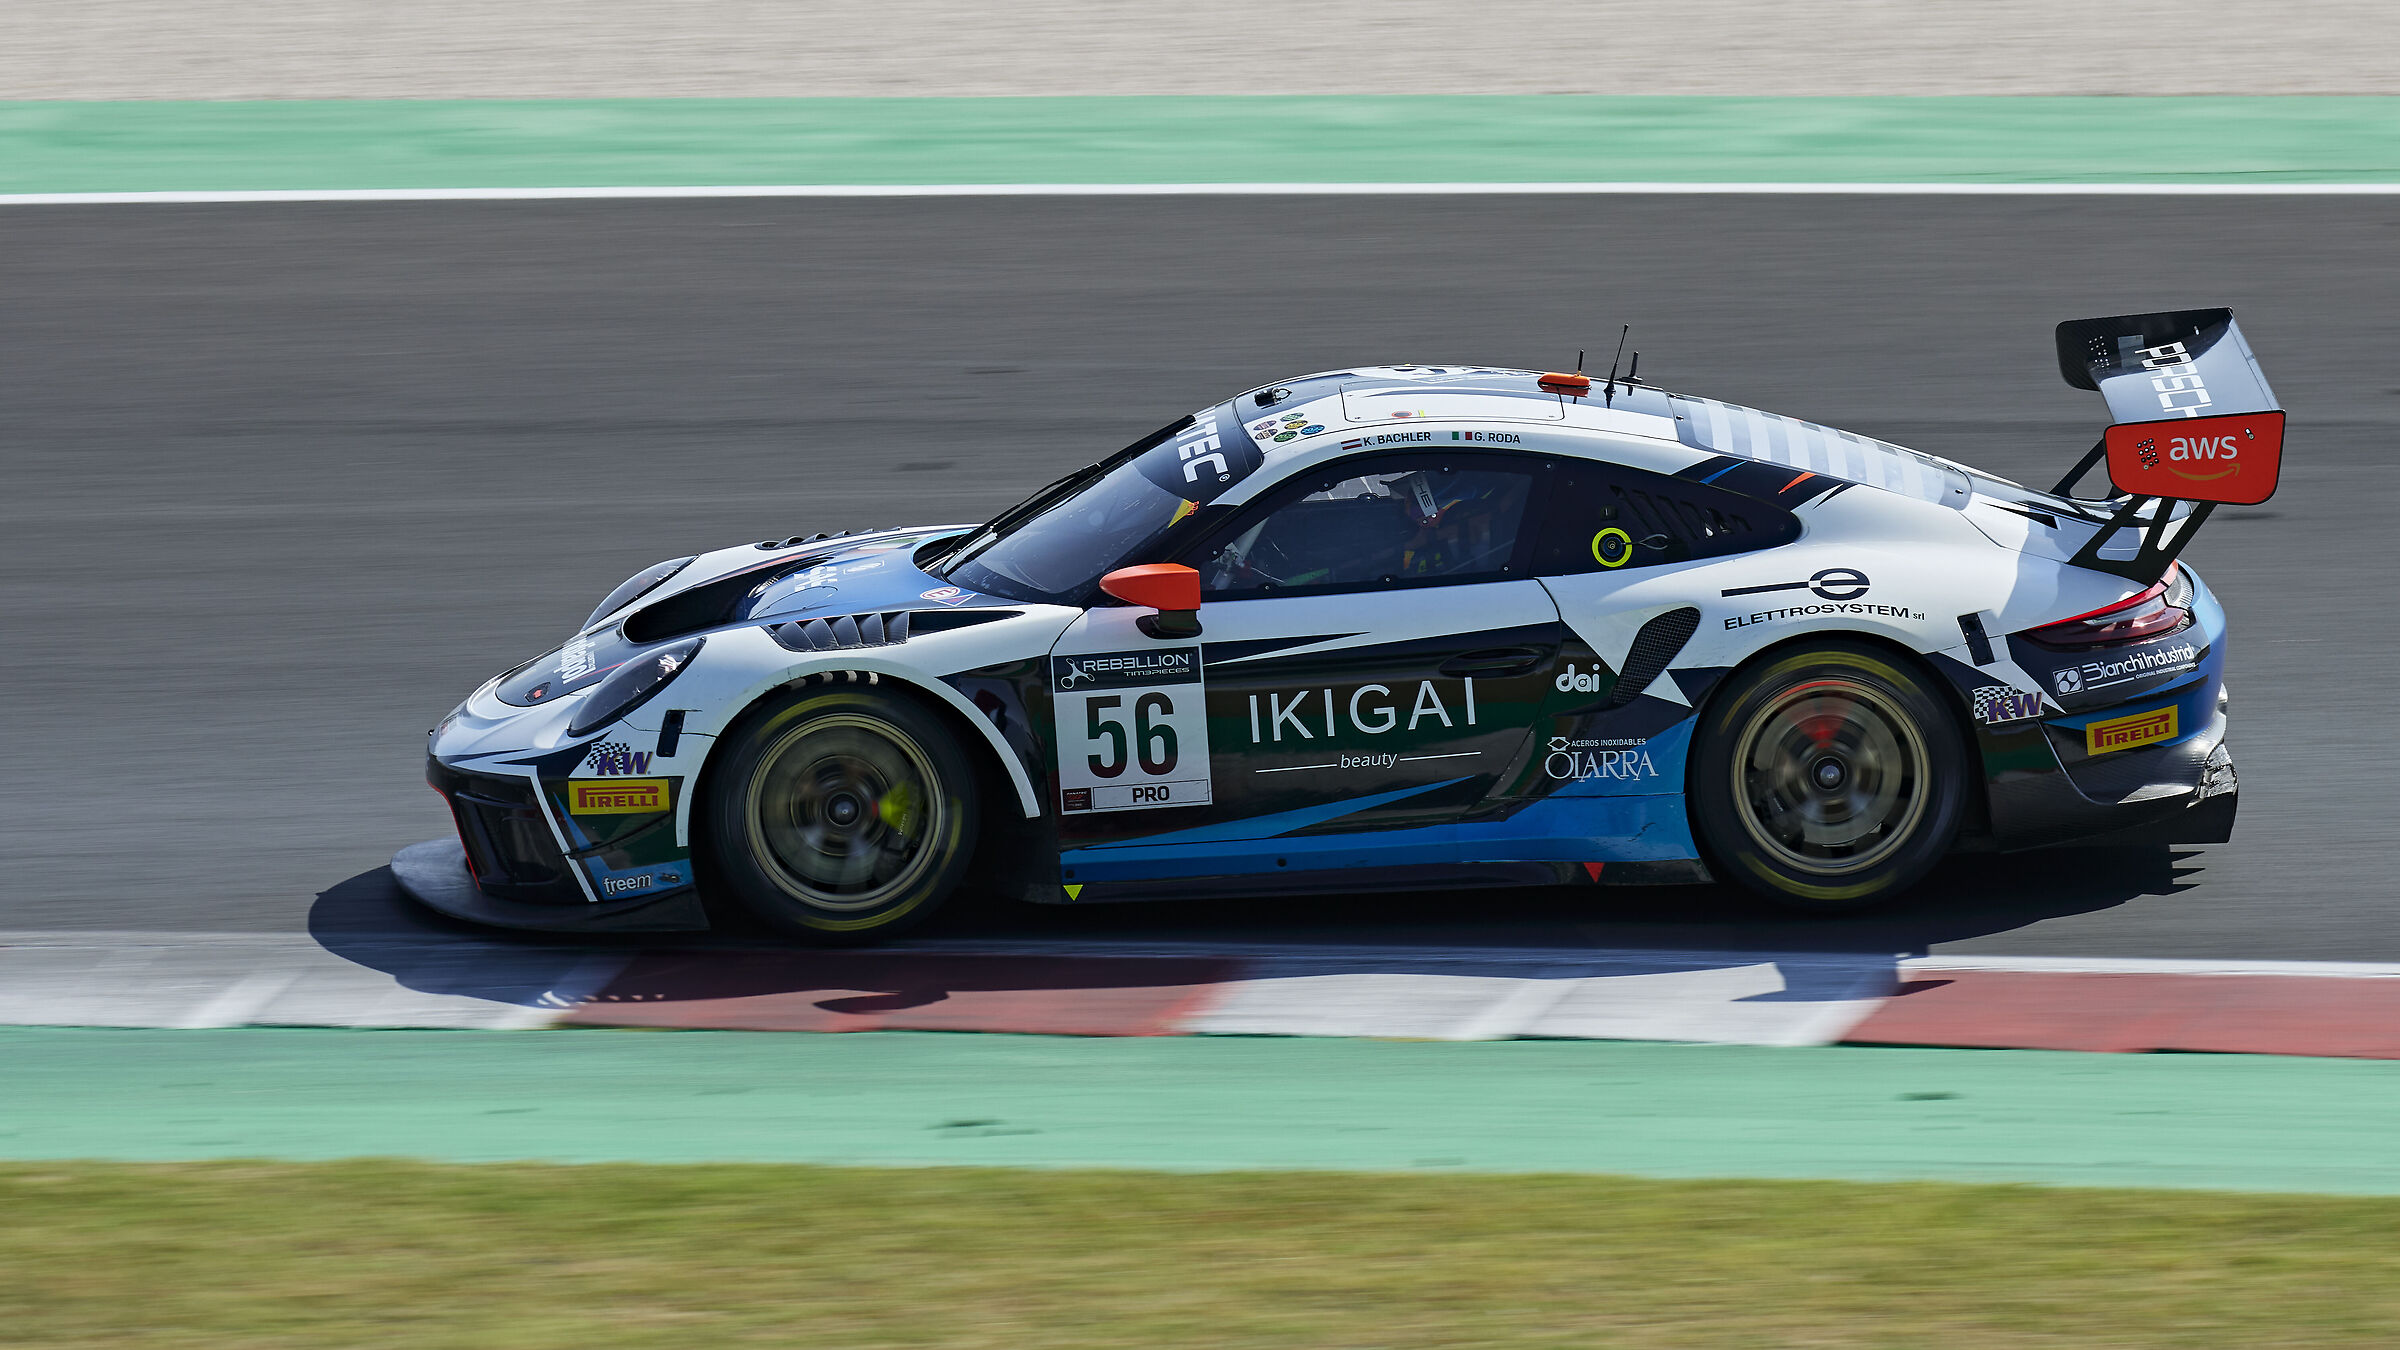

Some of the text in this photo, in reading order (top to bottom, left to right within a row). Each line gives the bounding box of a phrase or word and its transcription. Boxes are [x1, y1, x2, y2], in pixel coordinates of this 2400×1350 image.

[1363, 431, 1432, 446] K. BACHLER
[1474, 432, 1521, 444] G. RODA
[2169, 436, 2238, 461] aws
[1724, 603, 1925, 631] ELETTROSYSTEM srl
[1082, 653, 1190, 673] REBELLION
[1555, 663, 1600, 693] dai
[1249, 676, 1477, 744] IKIGAI
[1988, 691, 2042, 722] KW
[1086, 691, 1179, 779] 56
[1571, 738, 1647, 748] ACEROS INOXIDABLES
[2094, 713, 2170, 749] PIRELLI
[596, 751, 654, 776] KW
[1340, 752, 1398, 769] beauty
[1544, 750, 1660, 783] OLARRA
[577, 786, 659, 809] PIRELLI
[1132, 785, 1170, 803] PRO
[603, 874, 652, 894] freem
